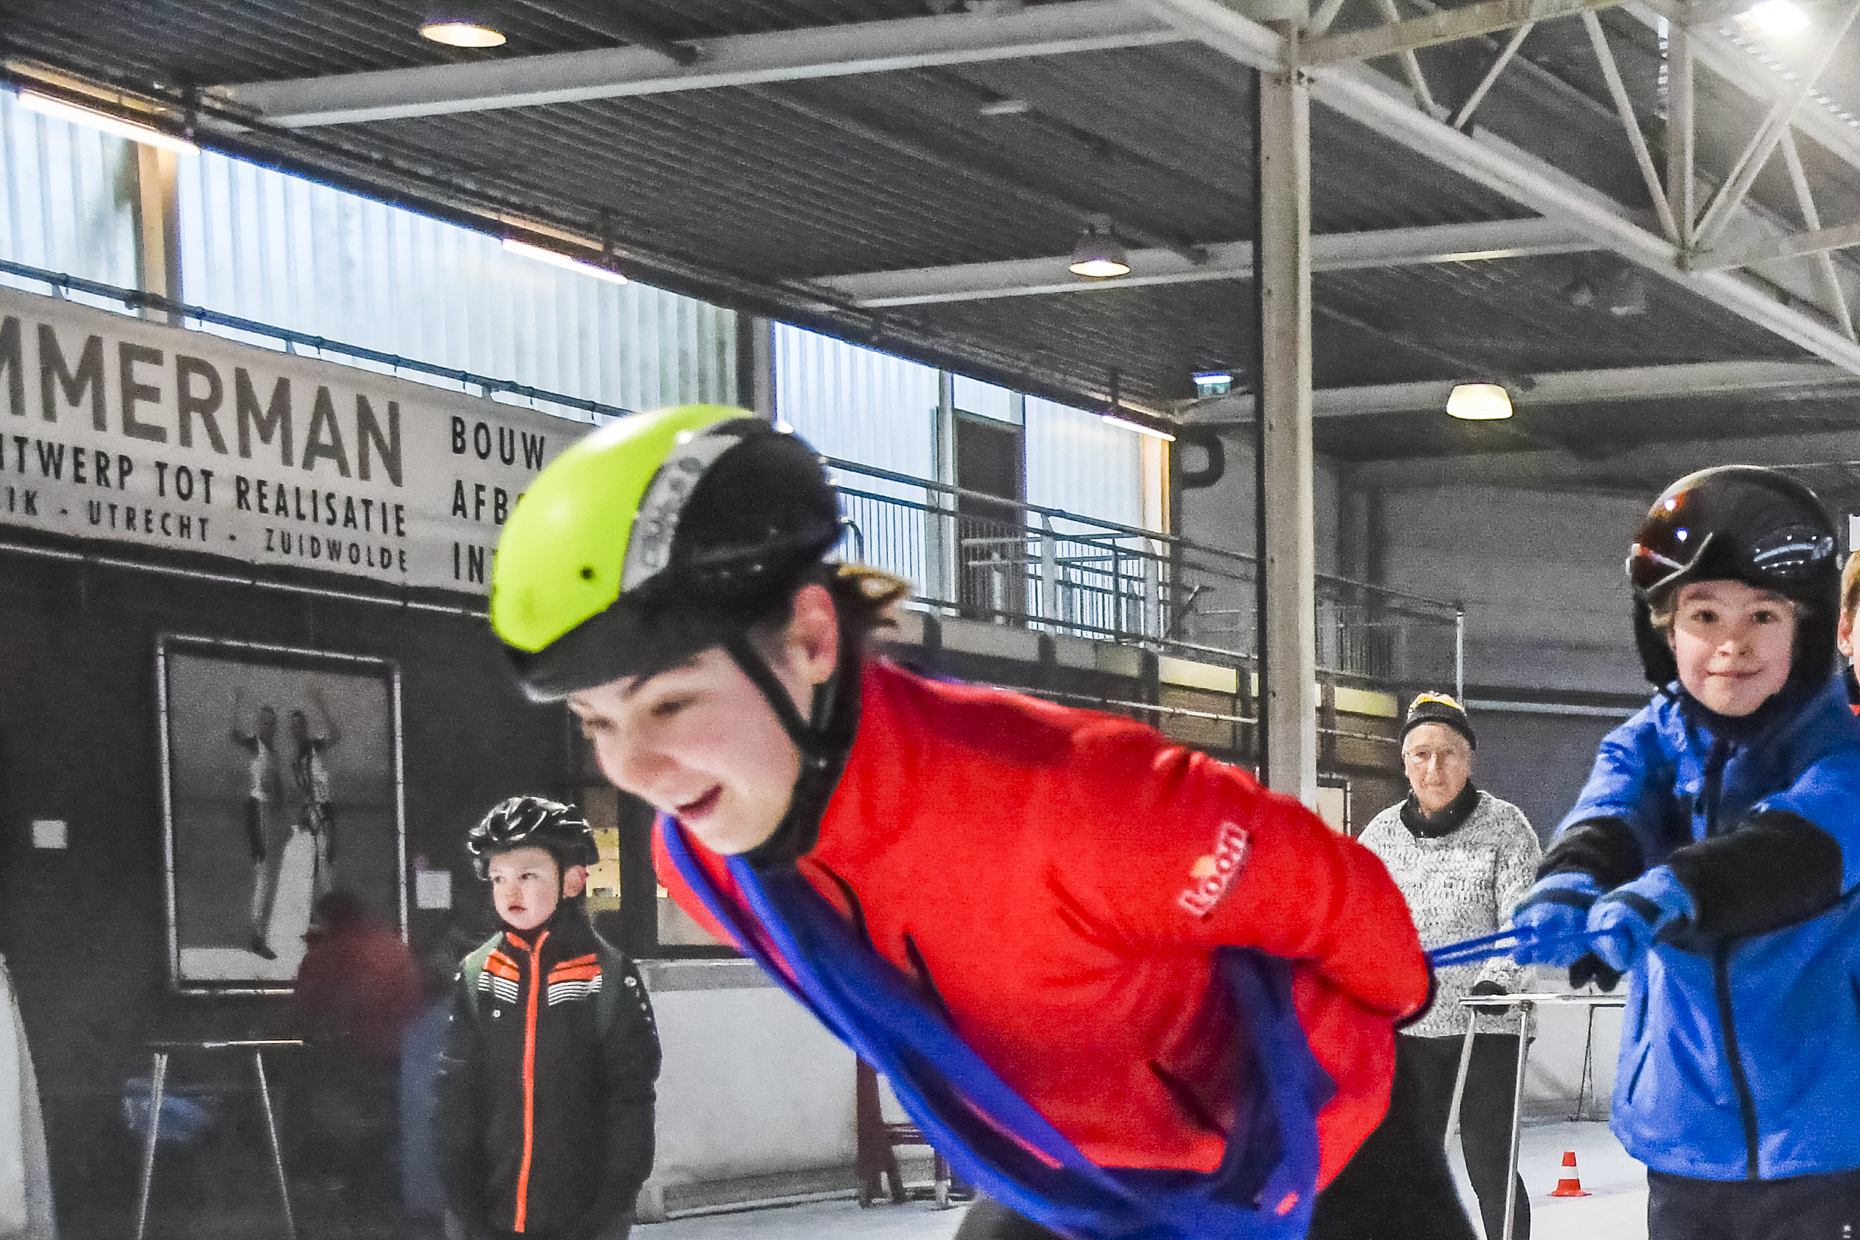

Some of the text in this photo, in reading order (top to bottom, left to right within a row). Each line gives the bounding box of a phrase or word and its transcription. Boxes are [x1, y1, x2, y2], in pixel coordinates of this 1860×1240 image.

[452, 415, 545, 472] BOUW
[0, 432, 406, 538] TWERP TOT REALISATIE
[89, 499, 209, 542] UTRECHT
[265, 527, 407, 572] ZUIDWOLDE
[453, 541, 498, 585] IN
